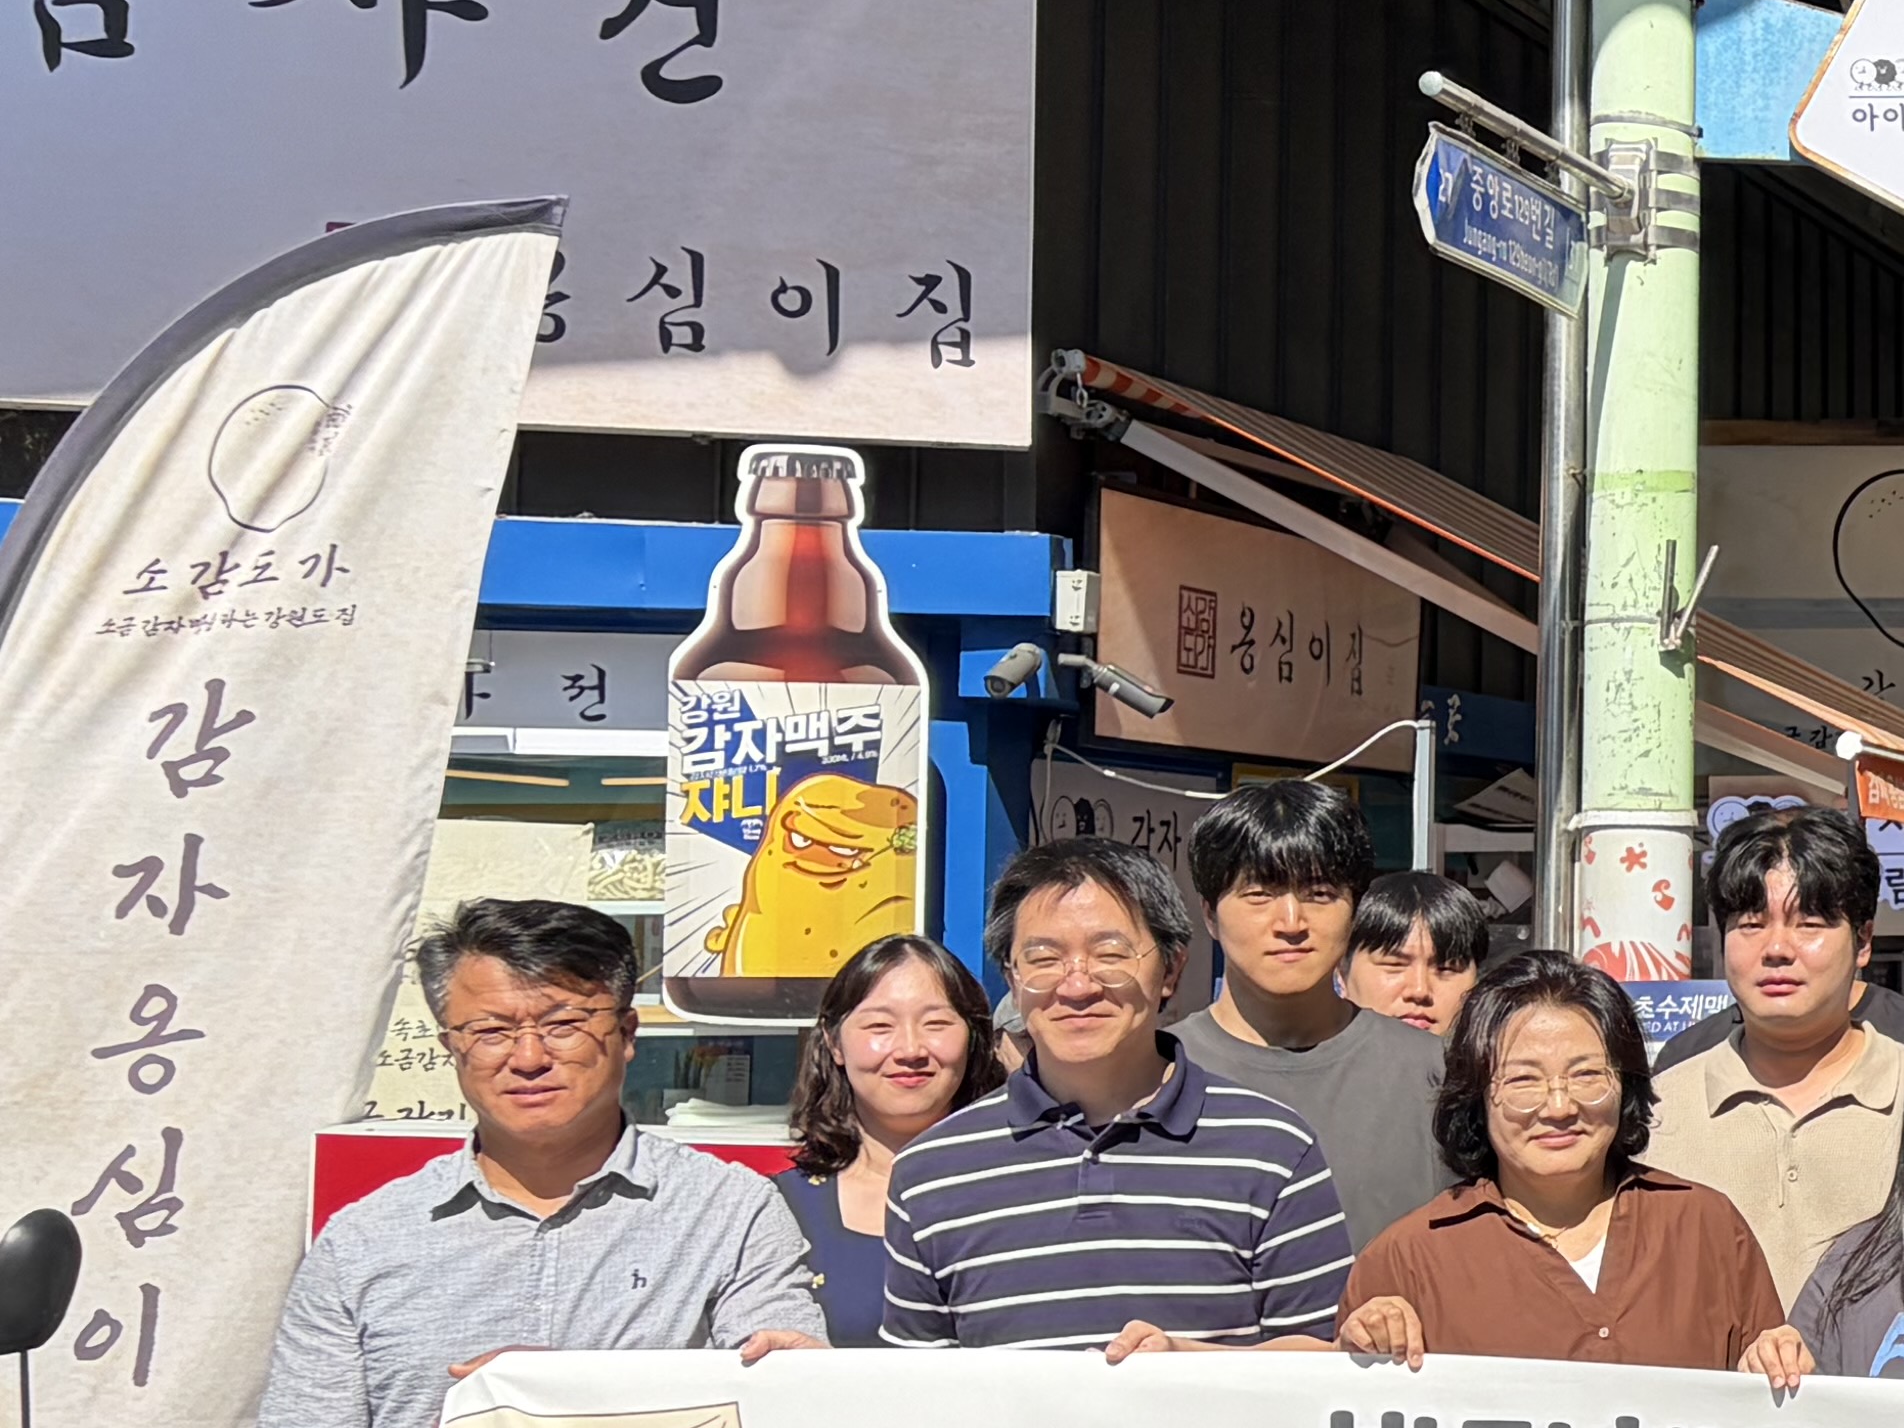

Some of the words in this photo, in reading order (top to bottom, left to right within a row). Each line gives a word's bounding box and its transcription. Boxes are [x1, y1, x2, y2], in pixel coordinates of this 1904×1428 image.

[1471, 166, 1555, 249] 중앙로129번길
[1230, 601, 1364, 696] 옹심이집
[680, 689, 740, 723] 강원
[680, 704, 882, 774] 감자맥주
[680, 767, 782, 824] 쟈니
[72, 677, 256, 1387] 감자옹심이
